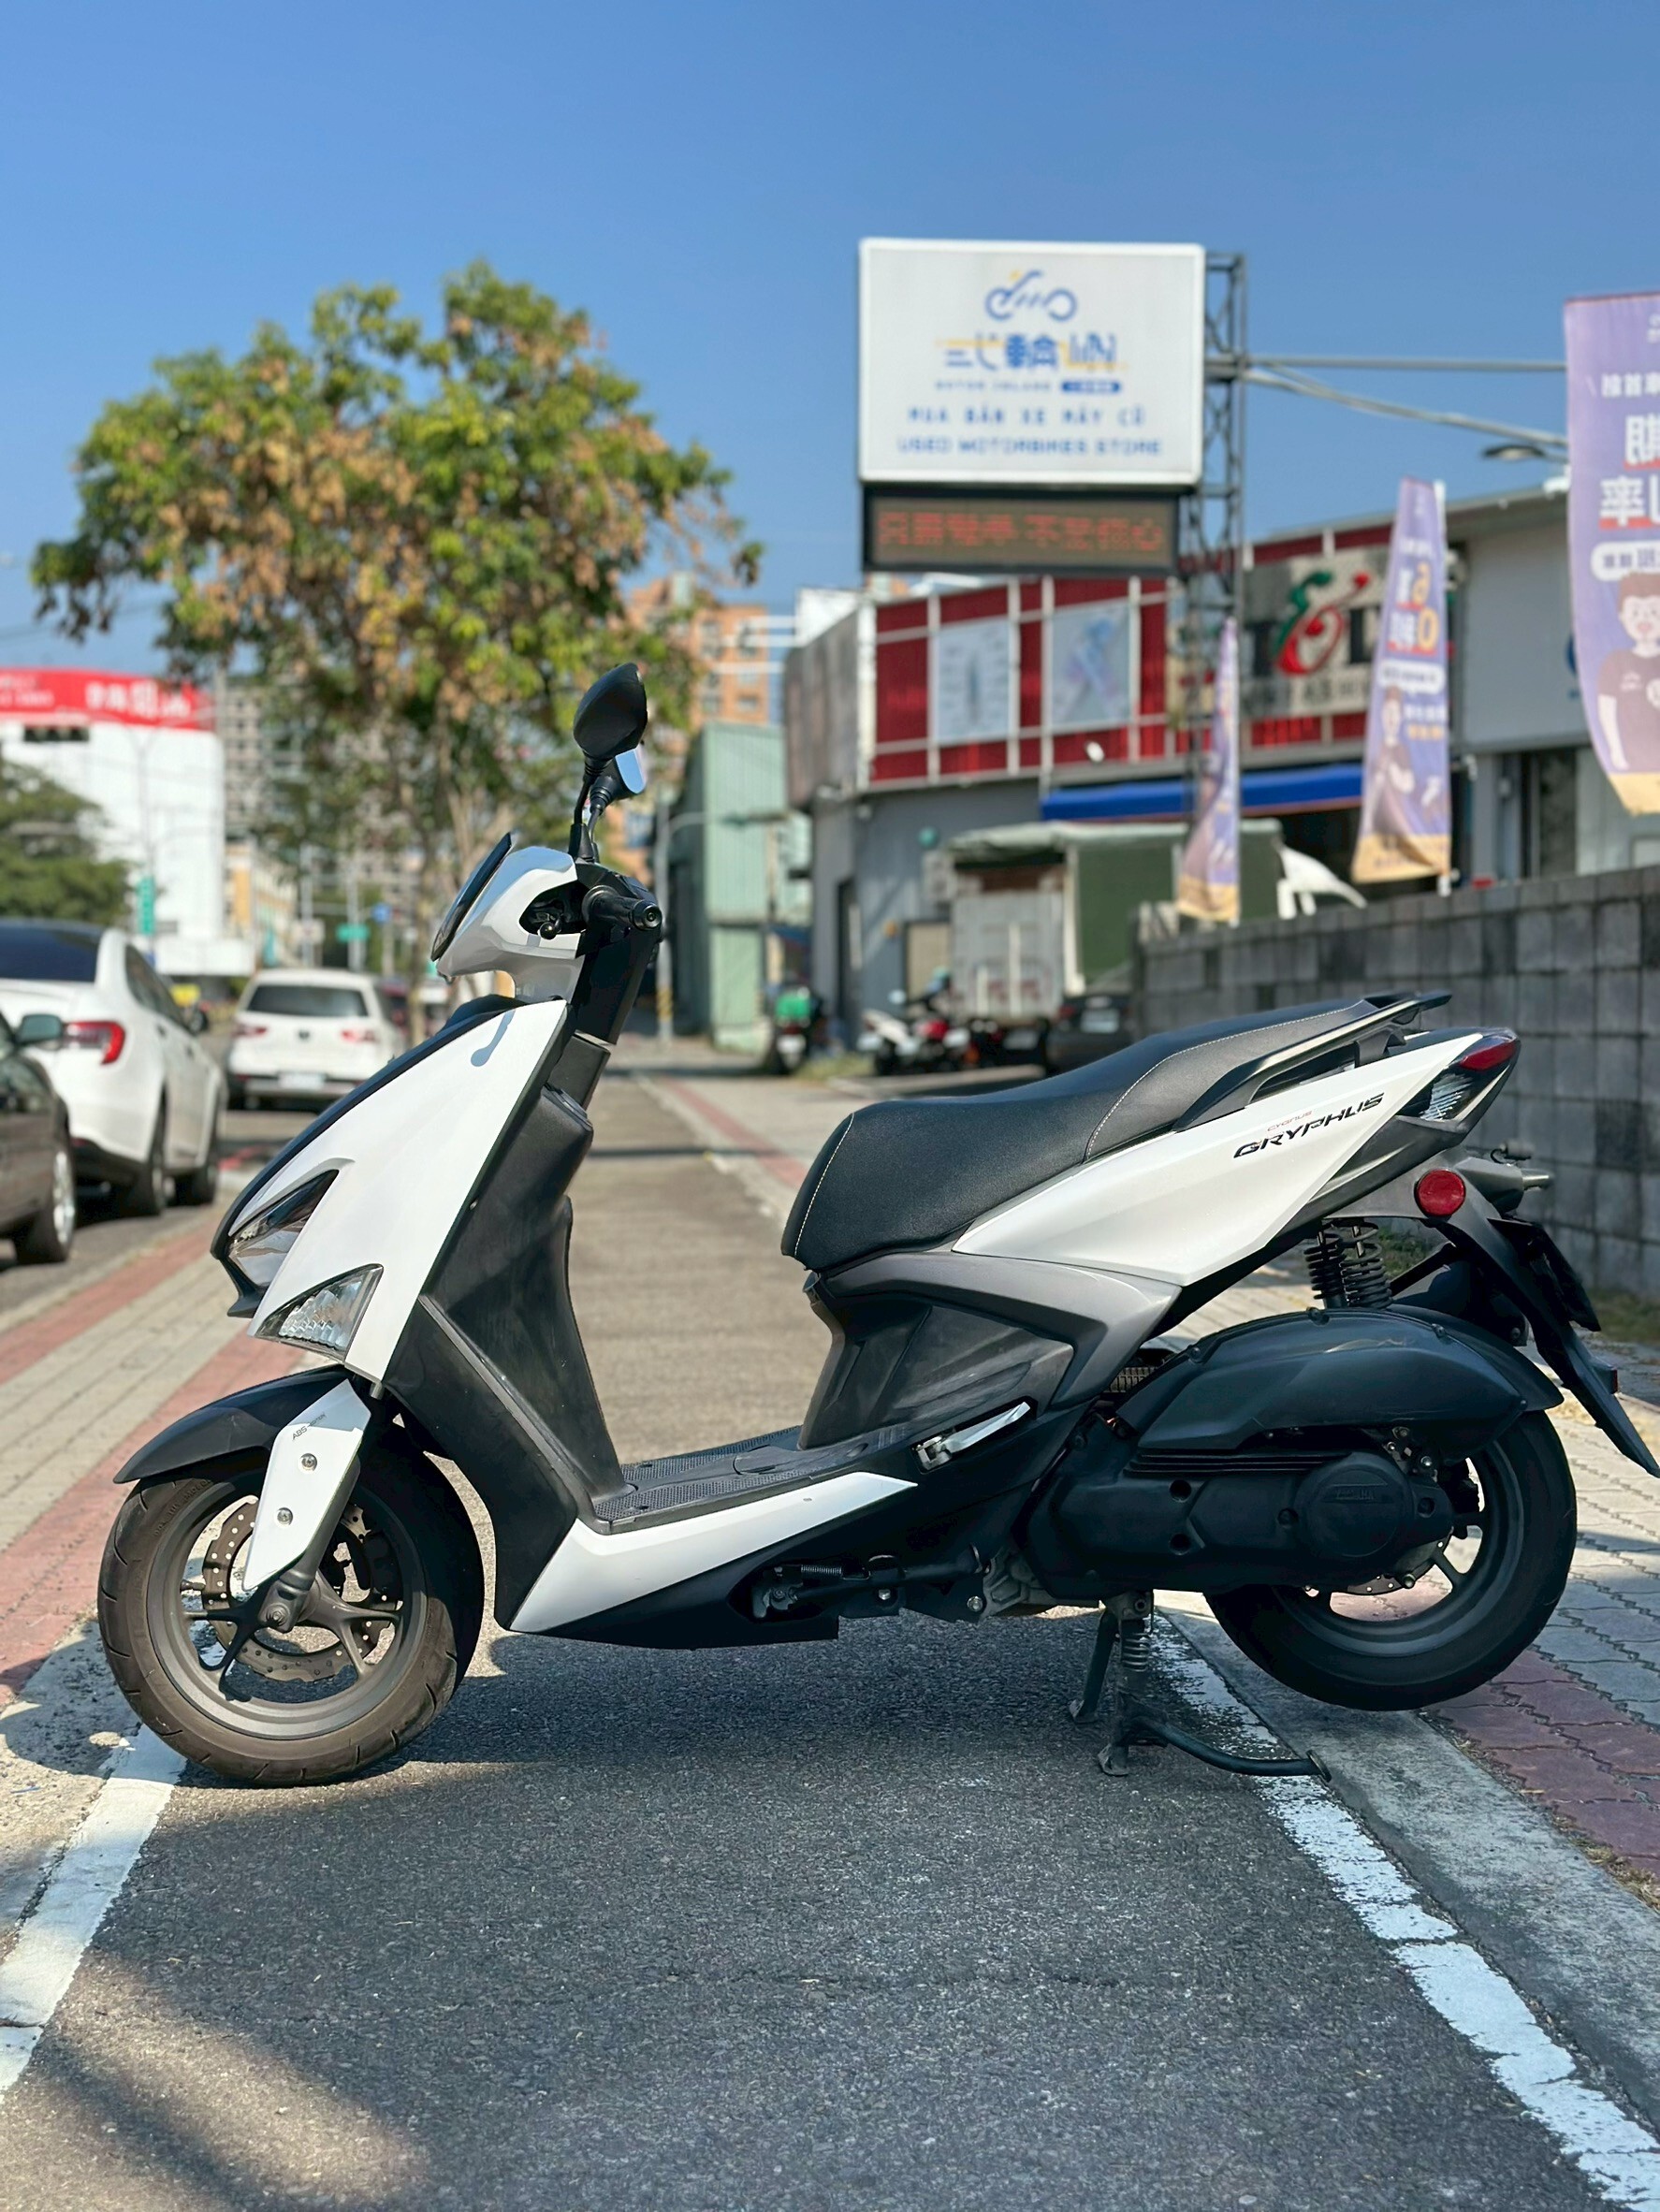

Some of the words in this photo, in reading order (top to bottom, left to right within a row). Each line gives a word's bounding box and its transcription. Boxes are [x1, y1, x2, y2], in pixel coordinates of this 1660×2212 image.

[896, 436, 952, 456] USED
[1095, 438, 1162, 458] STORE
[1233, 1092, 1385, 1158] GRYPHUS
[292, 1425, 308, 1441] ABS
